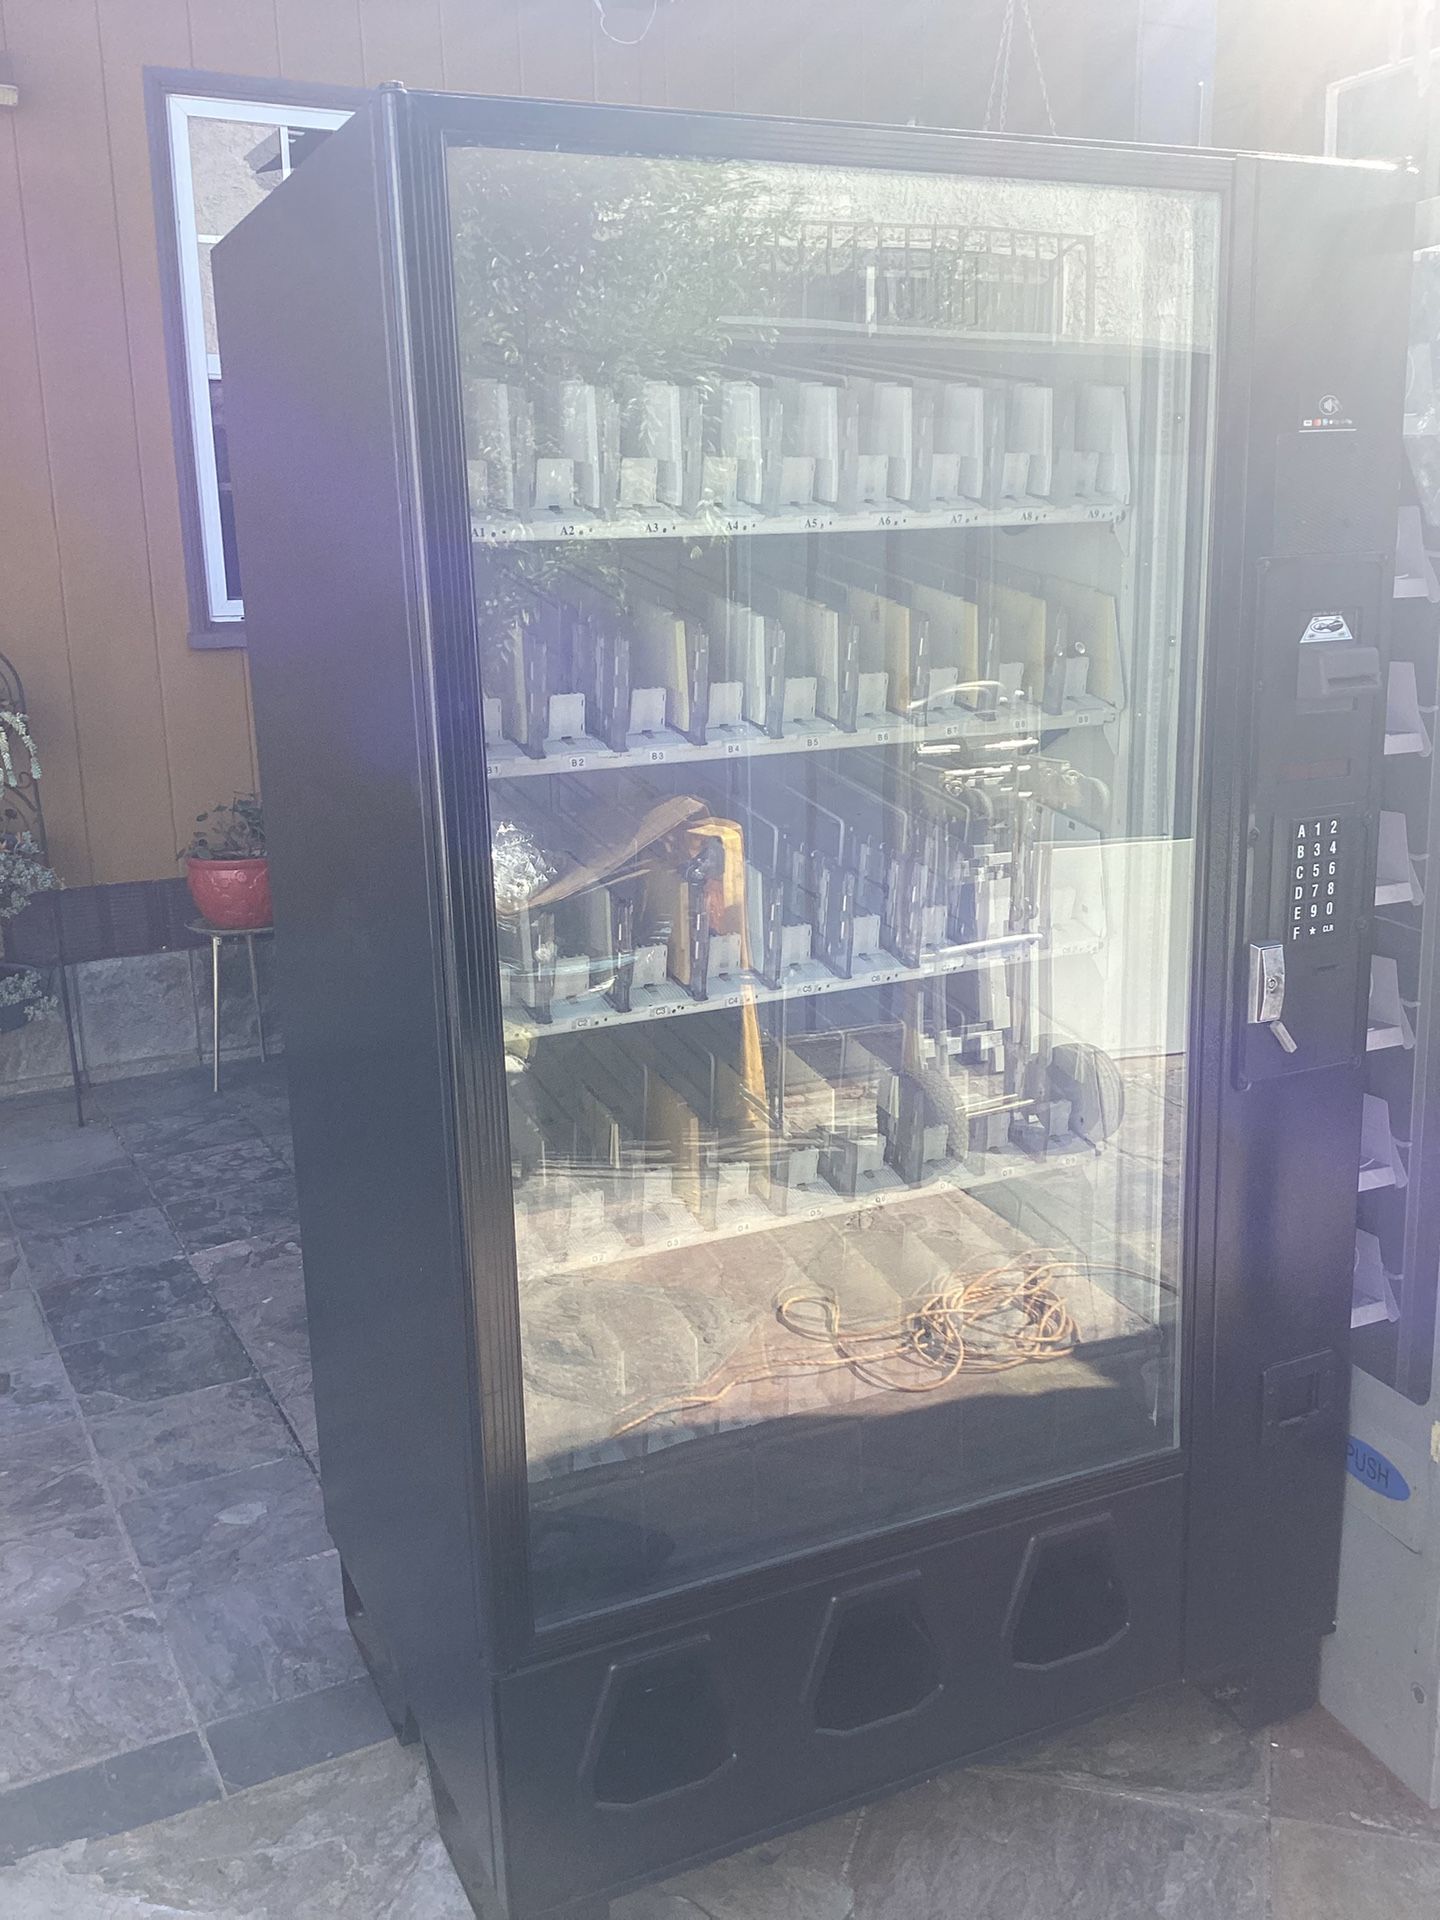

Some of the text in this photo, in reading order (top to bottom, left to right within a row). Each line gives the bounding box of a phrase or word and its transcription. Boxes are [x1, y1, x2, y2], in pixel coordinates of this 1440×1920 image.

[950, 514, 963, 525] A7
[1020, 512, 1034, 522] A8
[1087, 509, 1100, 520] A9
[725, 520, 740, 531] A4
[804, 518, 818, 530] A5
[878, 516, 891, 527] A6
[473, 528, 485, 538] A1
[559, 526, 575, 537] A2
[644, 523, 660, 534] A3
[806, 738, 820, 748] B5
[877, 733, 889, 742] B6
[727, 745, 740, 754] B4
[650, 752, 665, 761] B3
[570, 758, 585, 768] B2
[1297, 820, 1338, 838] A 1 2
[1296, 841, 1337, 858] B 3 4
[1295, 862, 1336, 879] C 5 6
[1294, 882, 1335, 899] D 7 8
[1293, 906, 1302, 920] E
[1309, 904, 1318, 917] 9
[1292, 926, 1301, 940] F
[1321, 924, 1335, 932] CLR
[801, 985, 813, 994] C5
[655, 1007, 666, 1016] C3
[1346, 1442, 1390, 1488] PUSH
